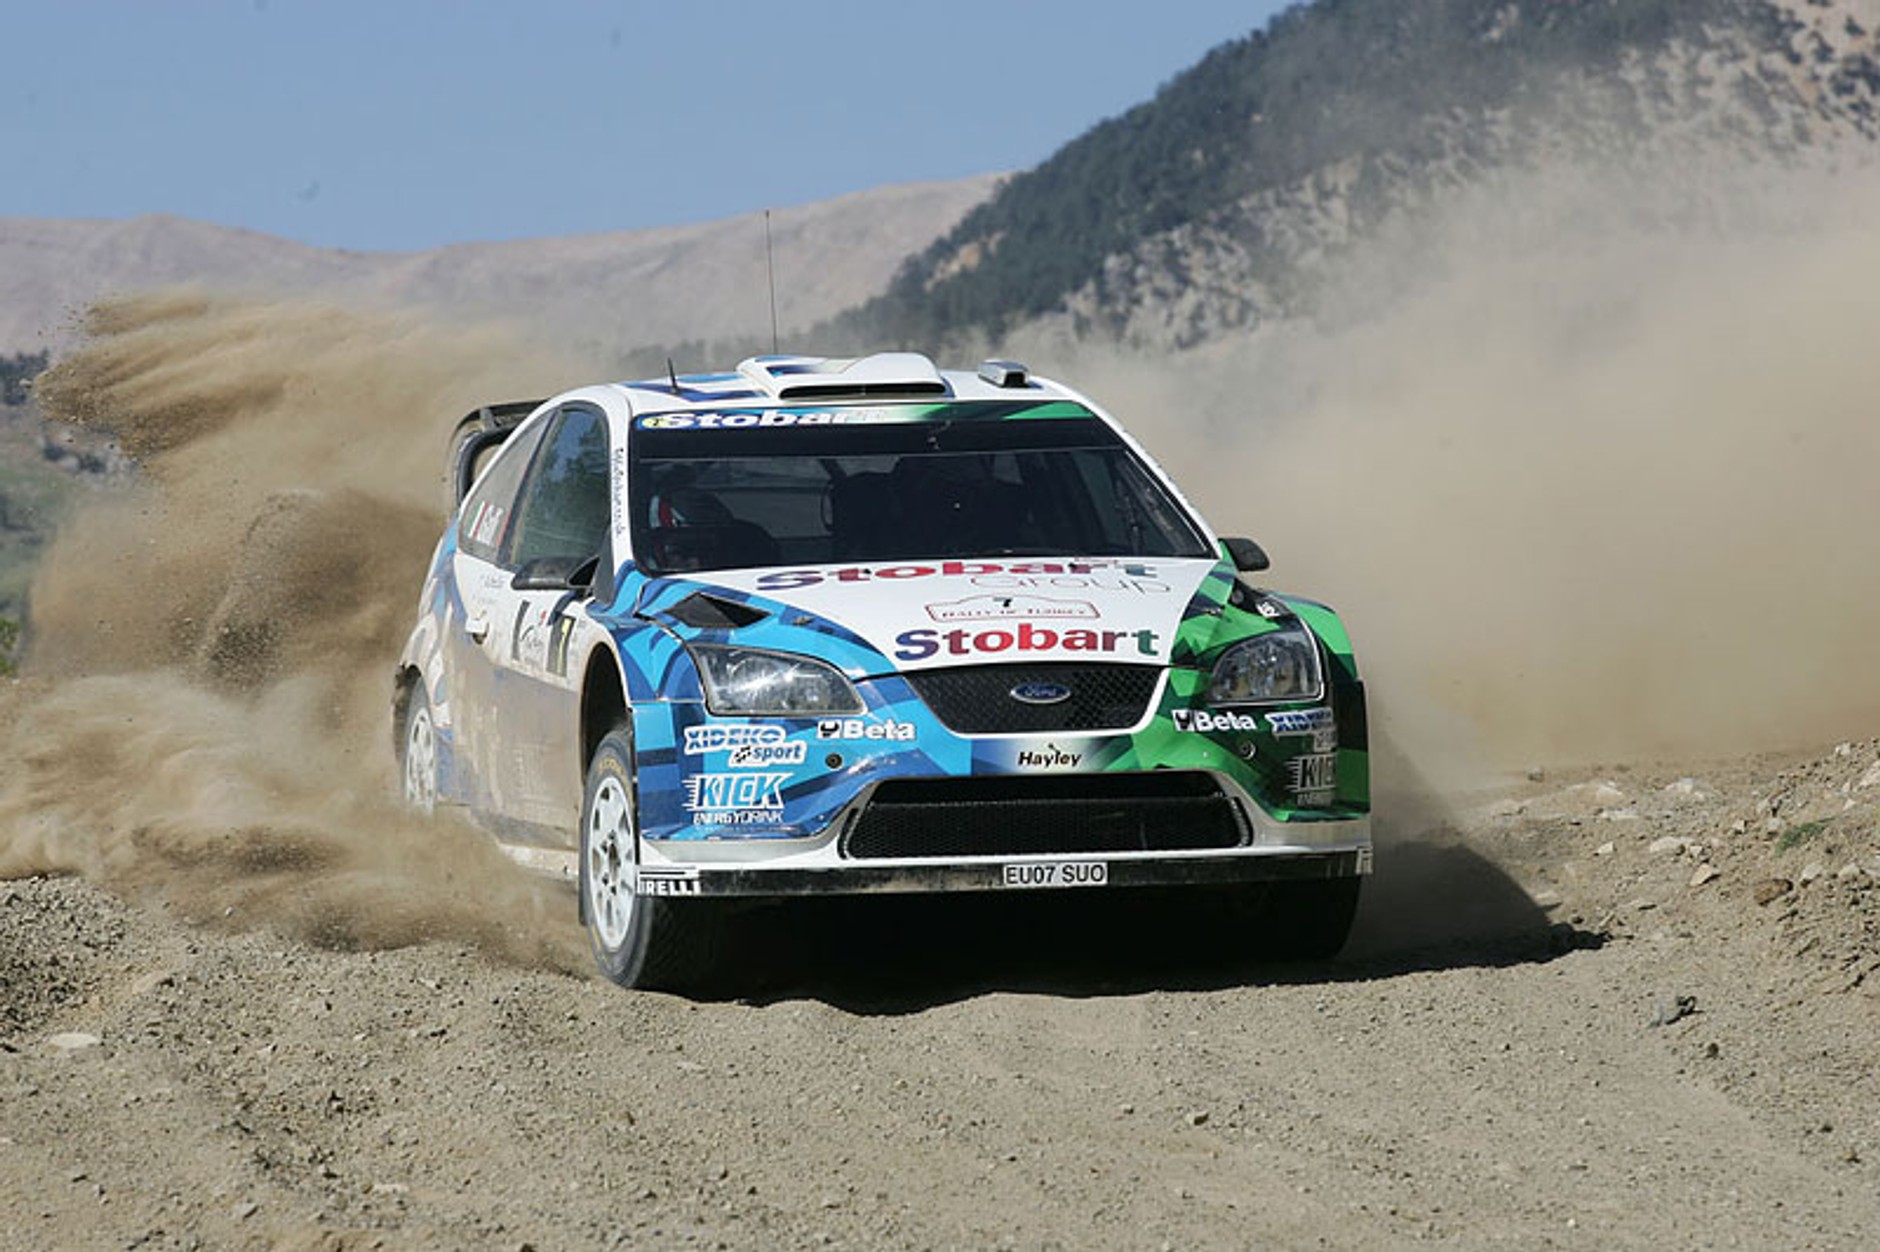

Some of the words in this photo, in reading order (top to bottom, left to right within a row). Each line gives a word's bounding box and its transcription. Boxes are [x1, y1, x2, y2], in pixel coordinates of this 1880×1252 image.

[756, 561, 1157, 590] Stobart
[895, 623, 1159, 661] Stobart
[843, 718, 917, 740] Beta
[1194, 711, 1258, 732] Beta
[686, 727, 783, 751] XIDEKO
[752, 744, 801, 763] sport
[1018, 743, 1082, 768] Hayley
[694, 772, 794, 809] KICK
[1005, 865, 1056, 885] EU07
[1061, 864, 1106, 883] SUO
